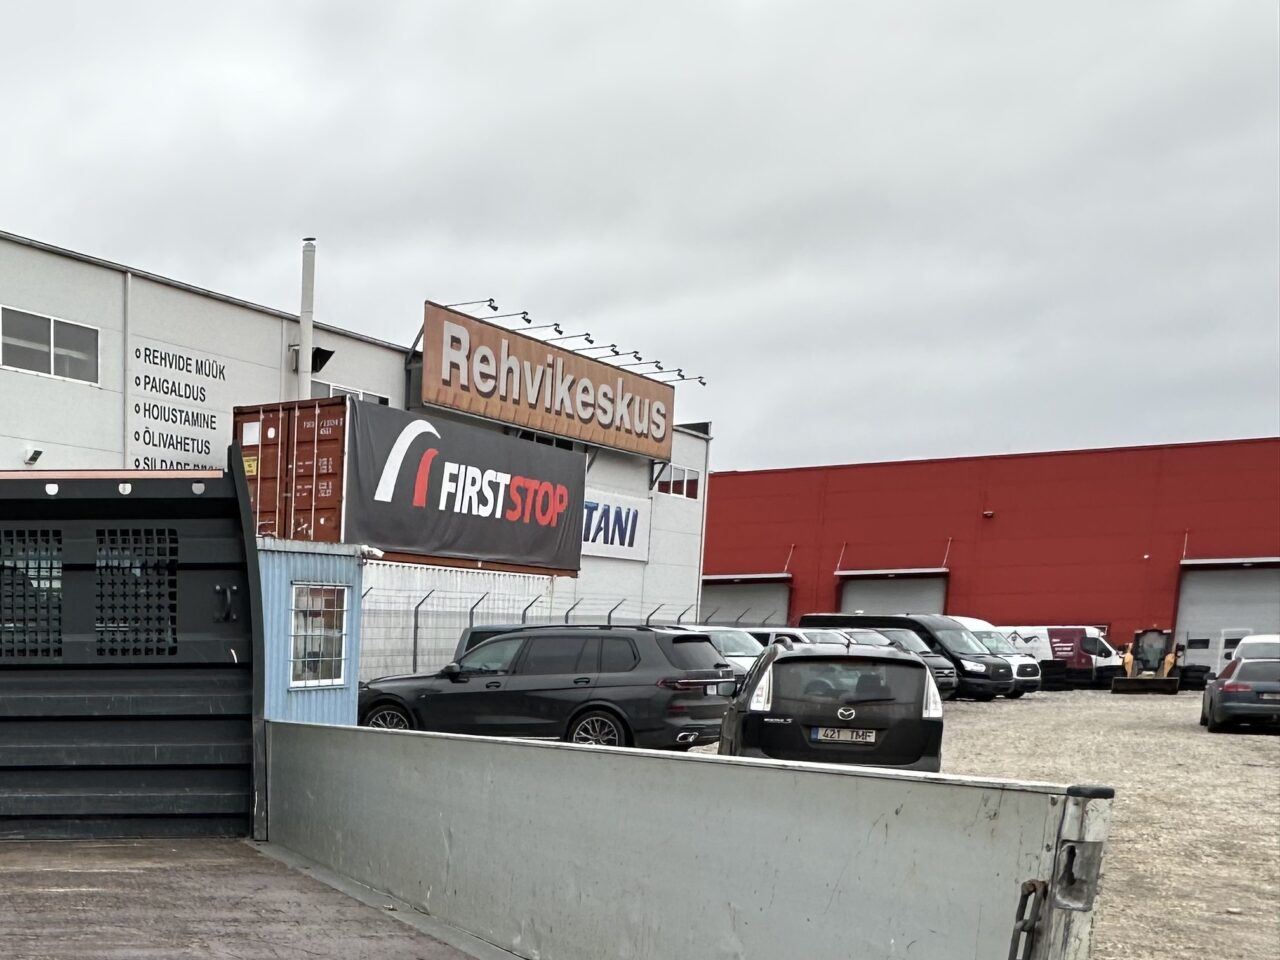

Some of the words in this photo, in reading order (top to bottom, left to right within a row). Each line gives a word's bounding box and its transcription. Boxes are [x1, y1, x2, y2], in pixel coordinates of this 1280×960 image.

[144, 347, 192, 373] REHVIDE
[195, 358, 226, 381] MÜÜK
[144, 375, 206, 402] PAIGALDUS
[441, 320, 666, 442] Rehvikeskus
[144, 403, 217, 430] HOIUSTAMINE
[143, 426, 211, 455] ÕLIVAHETUS
[822, 729, 841, 740] 421
